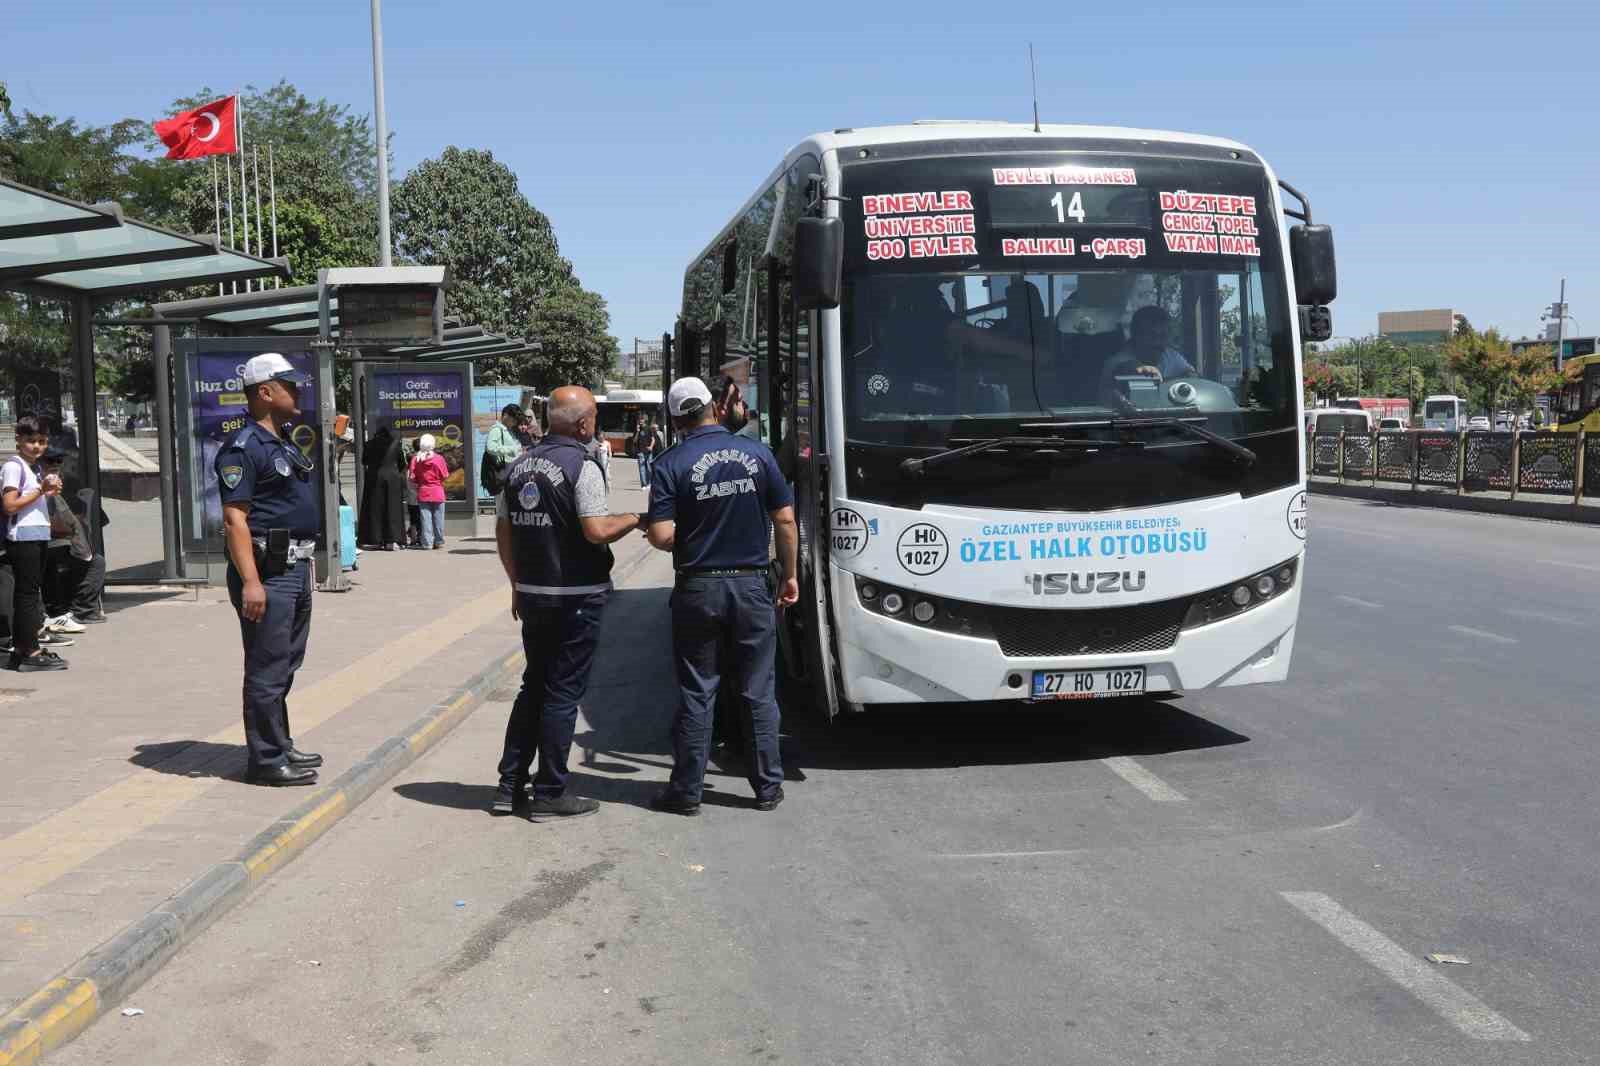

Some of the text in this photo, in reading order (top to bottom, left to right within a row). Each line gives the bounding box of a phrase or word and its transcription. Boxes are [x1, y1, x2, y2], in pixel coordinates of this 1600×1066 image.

[992, 169, 1051, 184] DEVLET
[1051, 191, 1085, 223] 14
[1160, 190, 1256, 215] DÜZTEPE
[1215, 215, 1258, 236] TOPEL
[868, 236, 977, 259] 500 EVLER
[1003, 238, 1075, 256] BALIKLI
[1164, 233, 1260, 256] VATAN MAH.
[695, 478, 757, 501] ZABITA
[510, 511, 553, 527] ZABITA
[831, 536, 859, 550] 1027
[960, 527, 1207, 563] ÖZEL HALK OTOBÜSÜ
[904, 550, 939, 565] 1027
[1030, 570, 1146, 596] ISUZU
[1045, 673, 1065, 693] 27
[1105, 670, 1142, 690] 1027
